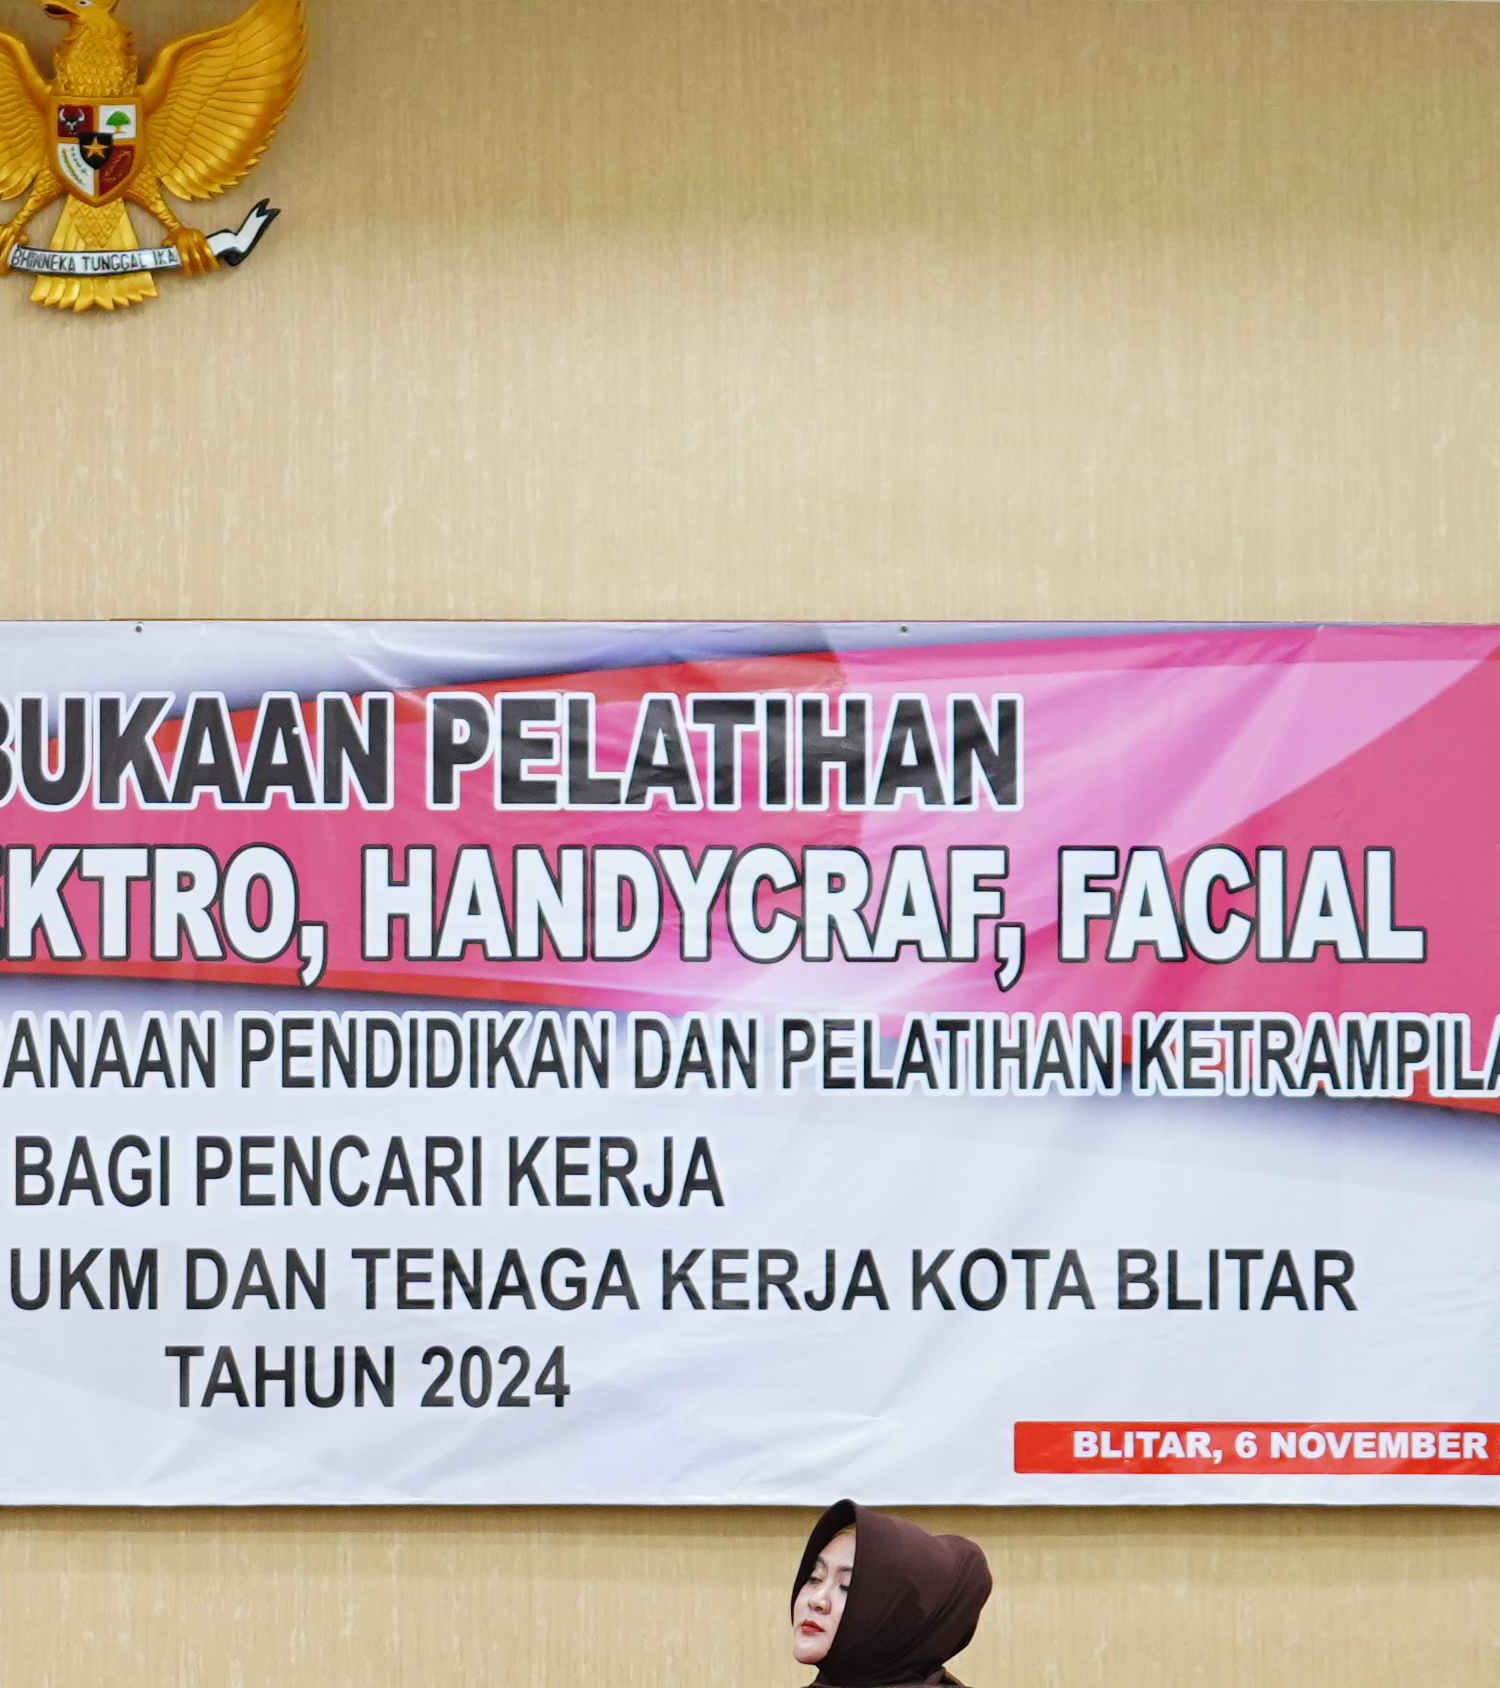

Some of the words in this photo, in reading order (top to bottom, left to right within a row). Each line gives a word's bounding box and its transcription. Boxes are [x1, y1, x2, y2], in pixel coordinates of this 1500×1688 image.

[11, 249, 76, 272] BHINNEKA
[82, 253, 147, 271] TUNGGAL
[153, 249, 178, 266] IKA
[433, 698, 1020, 805] PELATIHAN
[360, 844, 1027, 992] HANDYCRAF,
[1057, 845, 1428, 964] FACIAL
[239, 1017, 610, 1091] PENDIDIKAN
[646, 1017, 756, 1091] DAN
[782, 1017, 1117, 1091] PELATIHAN
[16, 1135, 169, 1207] BAGI
[196, 1135, 482, 1207] PENCARI
[509, 1135, 724, 1207] KERJA
[10, 1247, 156, 1312] UKM
[187, 1247, 326, 1312] DAN
[351, 1247, 639, 1312] TENAGA
[663, 1247, 890, 1312] KERJA
[912, 1247, 1094, 1312] KOTA
[1120, 1247, 1358, 1312] BLITAR
[163, 1345, 396, 1408] TAHUN
[421, 1345, 571, 1408] 2024
[1073, 1431, 1223, 1463] BLITAR,
[1234, 1431, 1255, 1459] 6
[1270, 1431, 1489, 1459] NOVEMBER
